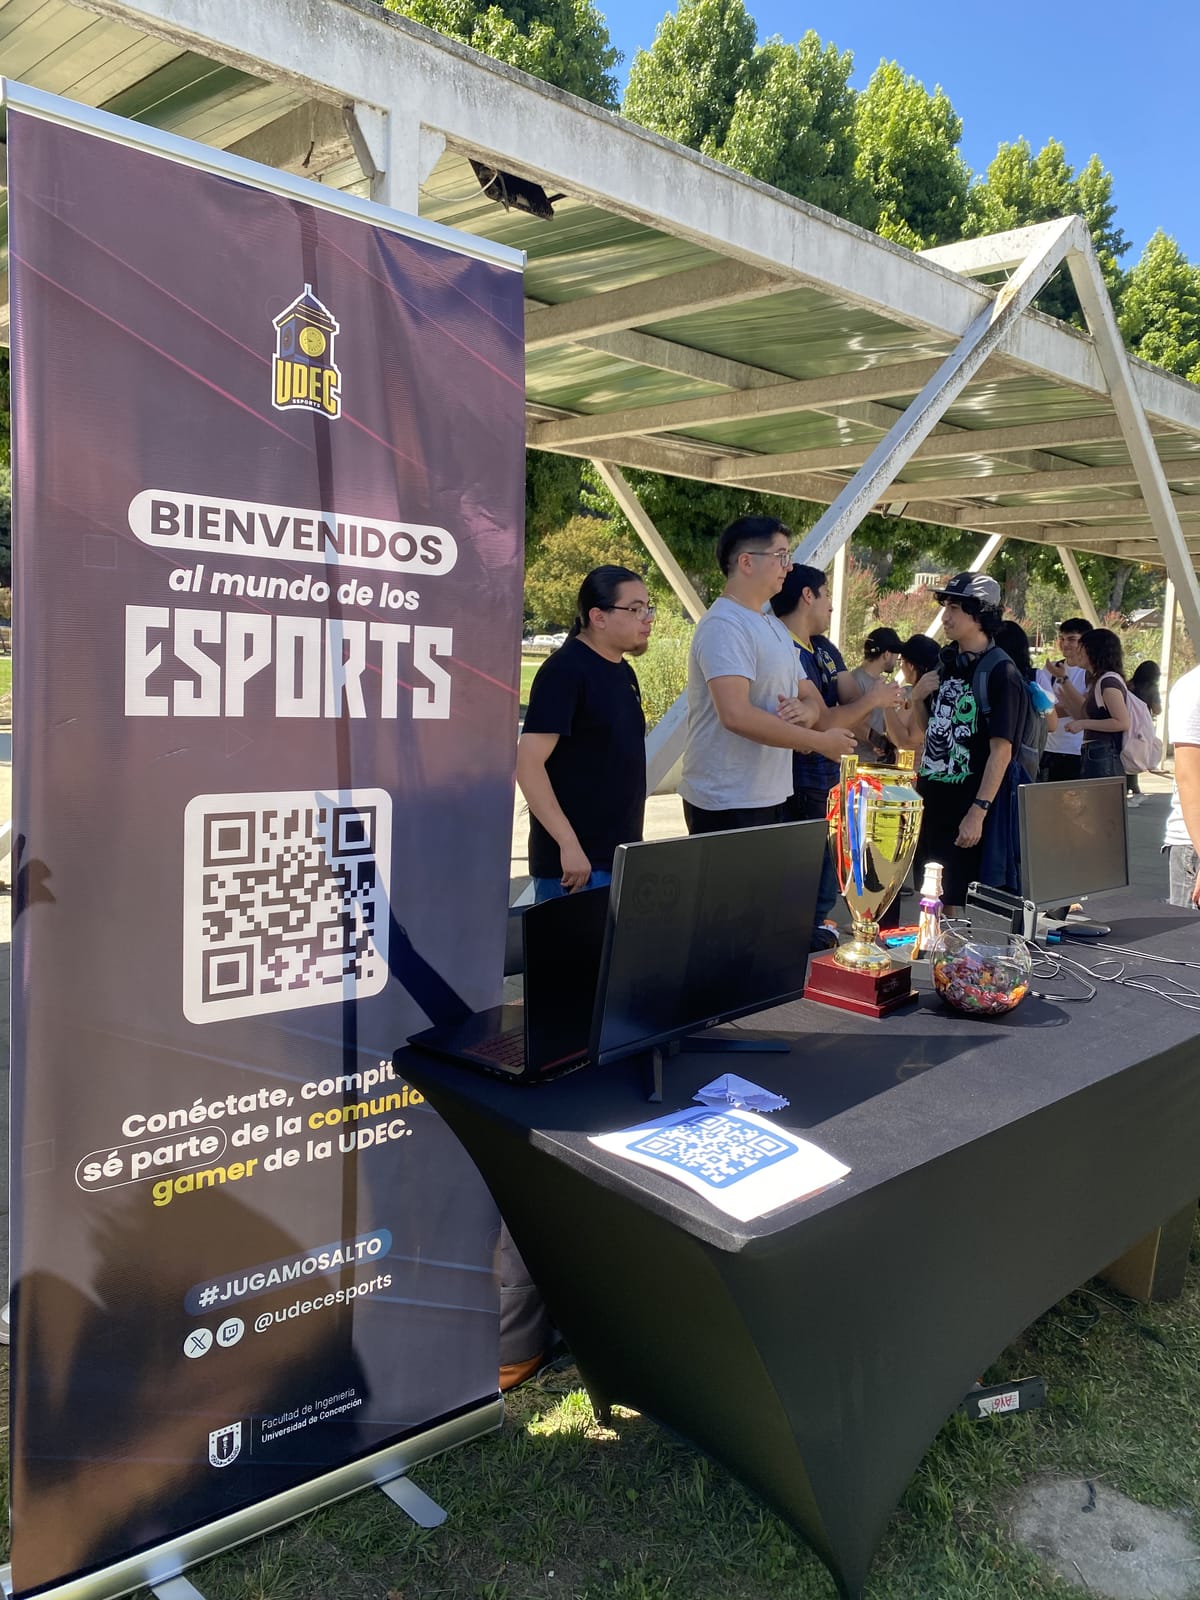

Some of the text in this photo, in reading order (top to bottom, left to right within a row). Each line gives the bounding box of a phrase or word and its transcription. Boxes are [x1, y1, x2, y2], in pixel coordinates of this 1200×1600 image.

[276, 359, 337, 414] UDEC
[150, 499, 443, 566] BIENVENIDOS
[168, 564, 420, 610] al mundo de los
[124, 605, 453, 719] ESPORTS
[122, 1060, 400, 1138] Conéctate, compit
[83, 1150, 124, 1182] sé
[131, 1136, 219, 1179] parte
[231, 1123, 269, 1147] de
[275, 1116, 302, 1138] la
[152, 1118, 413, 1207] gamer de la UDEC.
[199, 1237, 382, 1308] #JUGAMOSALTO
[254, 1274, 392, 1333] @udecesports
[261, 1388, 355, 1431] Facultad de Ingeniería
[261, 1398, 362, 1443] Universidad de Concepción
